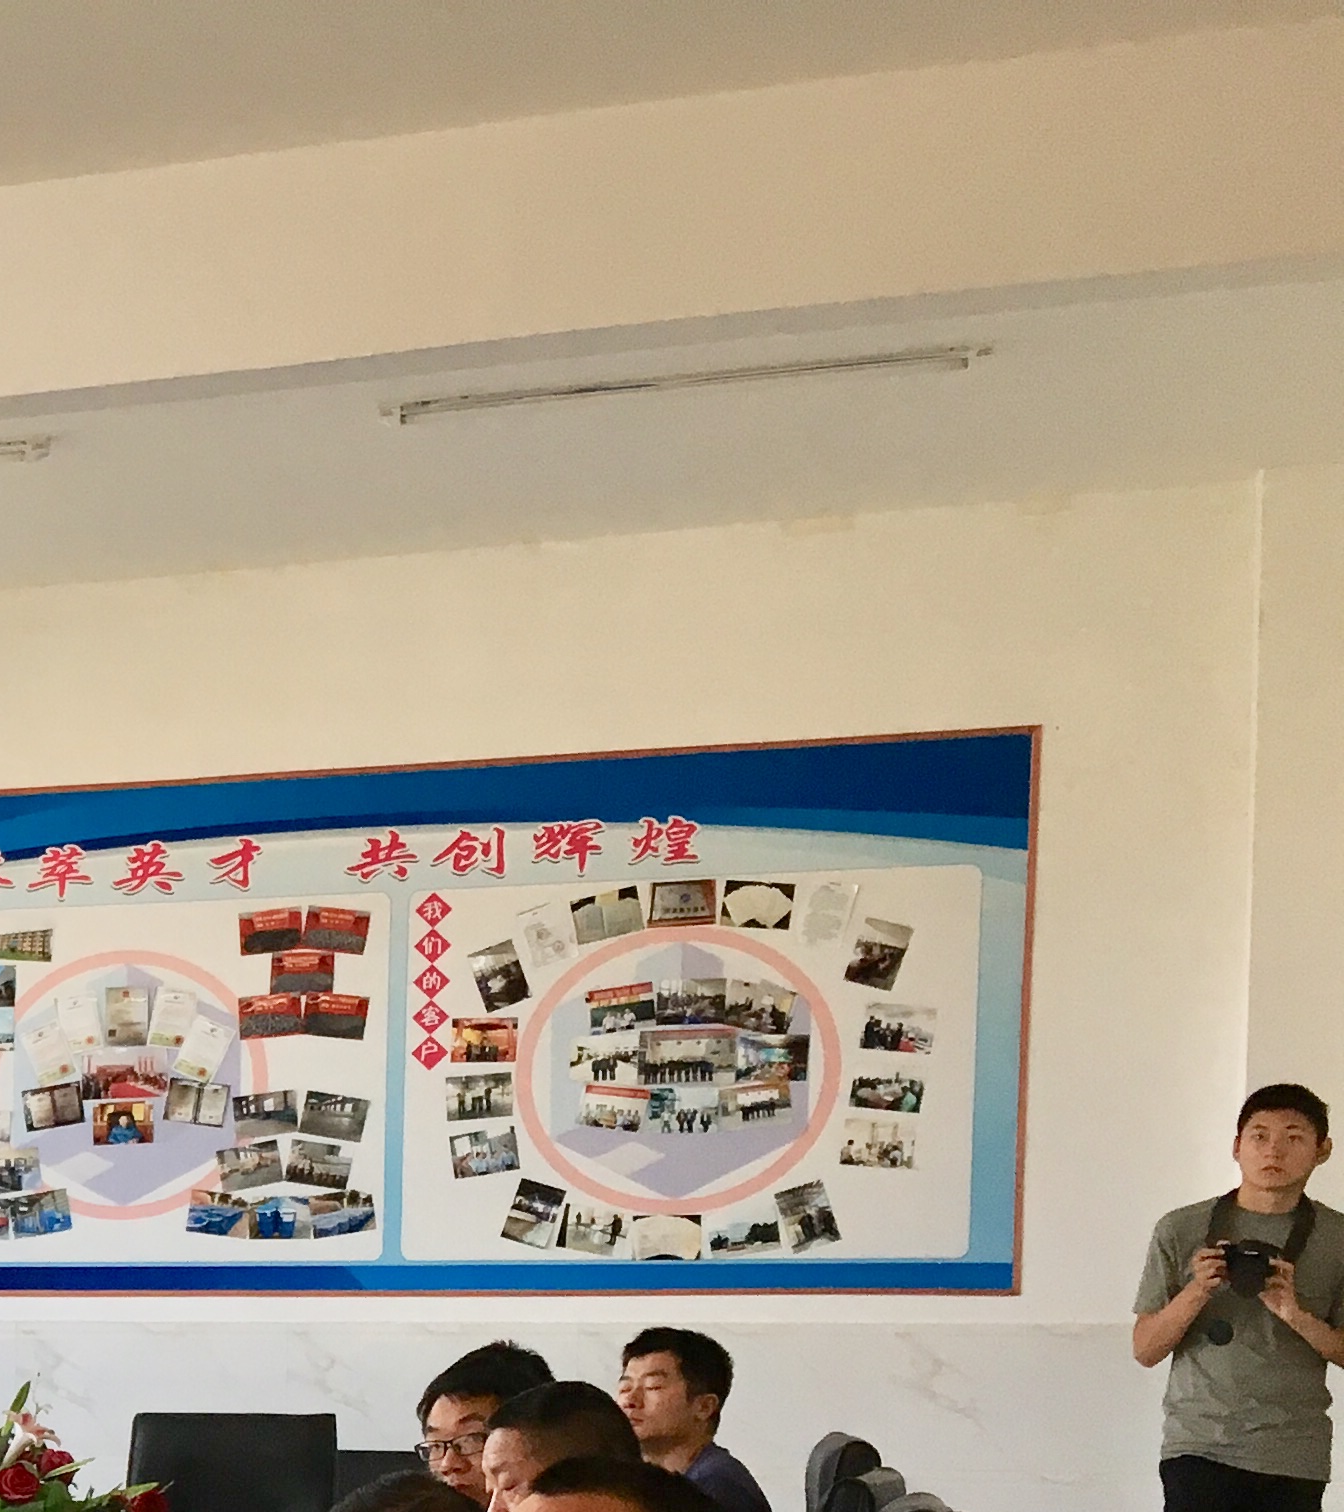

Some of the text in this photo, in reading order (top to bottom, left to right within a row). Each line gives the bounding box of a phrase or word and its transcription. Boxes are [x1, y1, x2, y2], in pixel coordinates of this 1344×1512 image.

[345, 816, 702, 883] 共创辉煌
[419, 900, 443, 1062] 我们的客户
